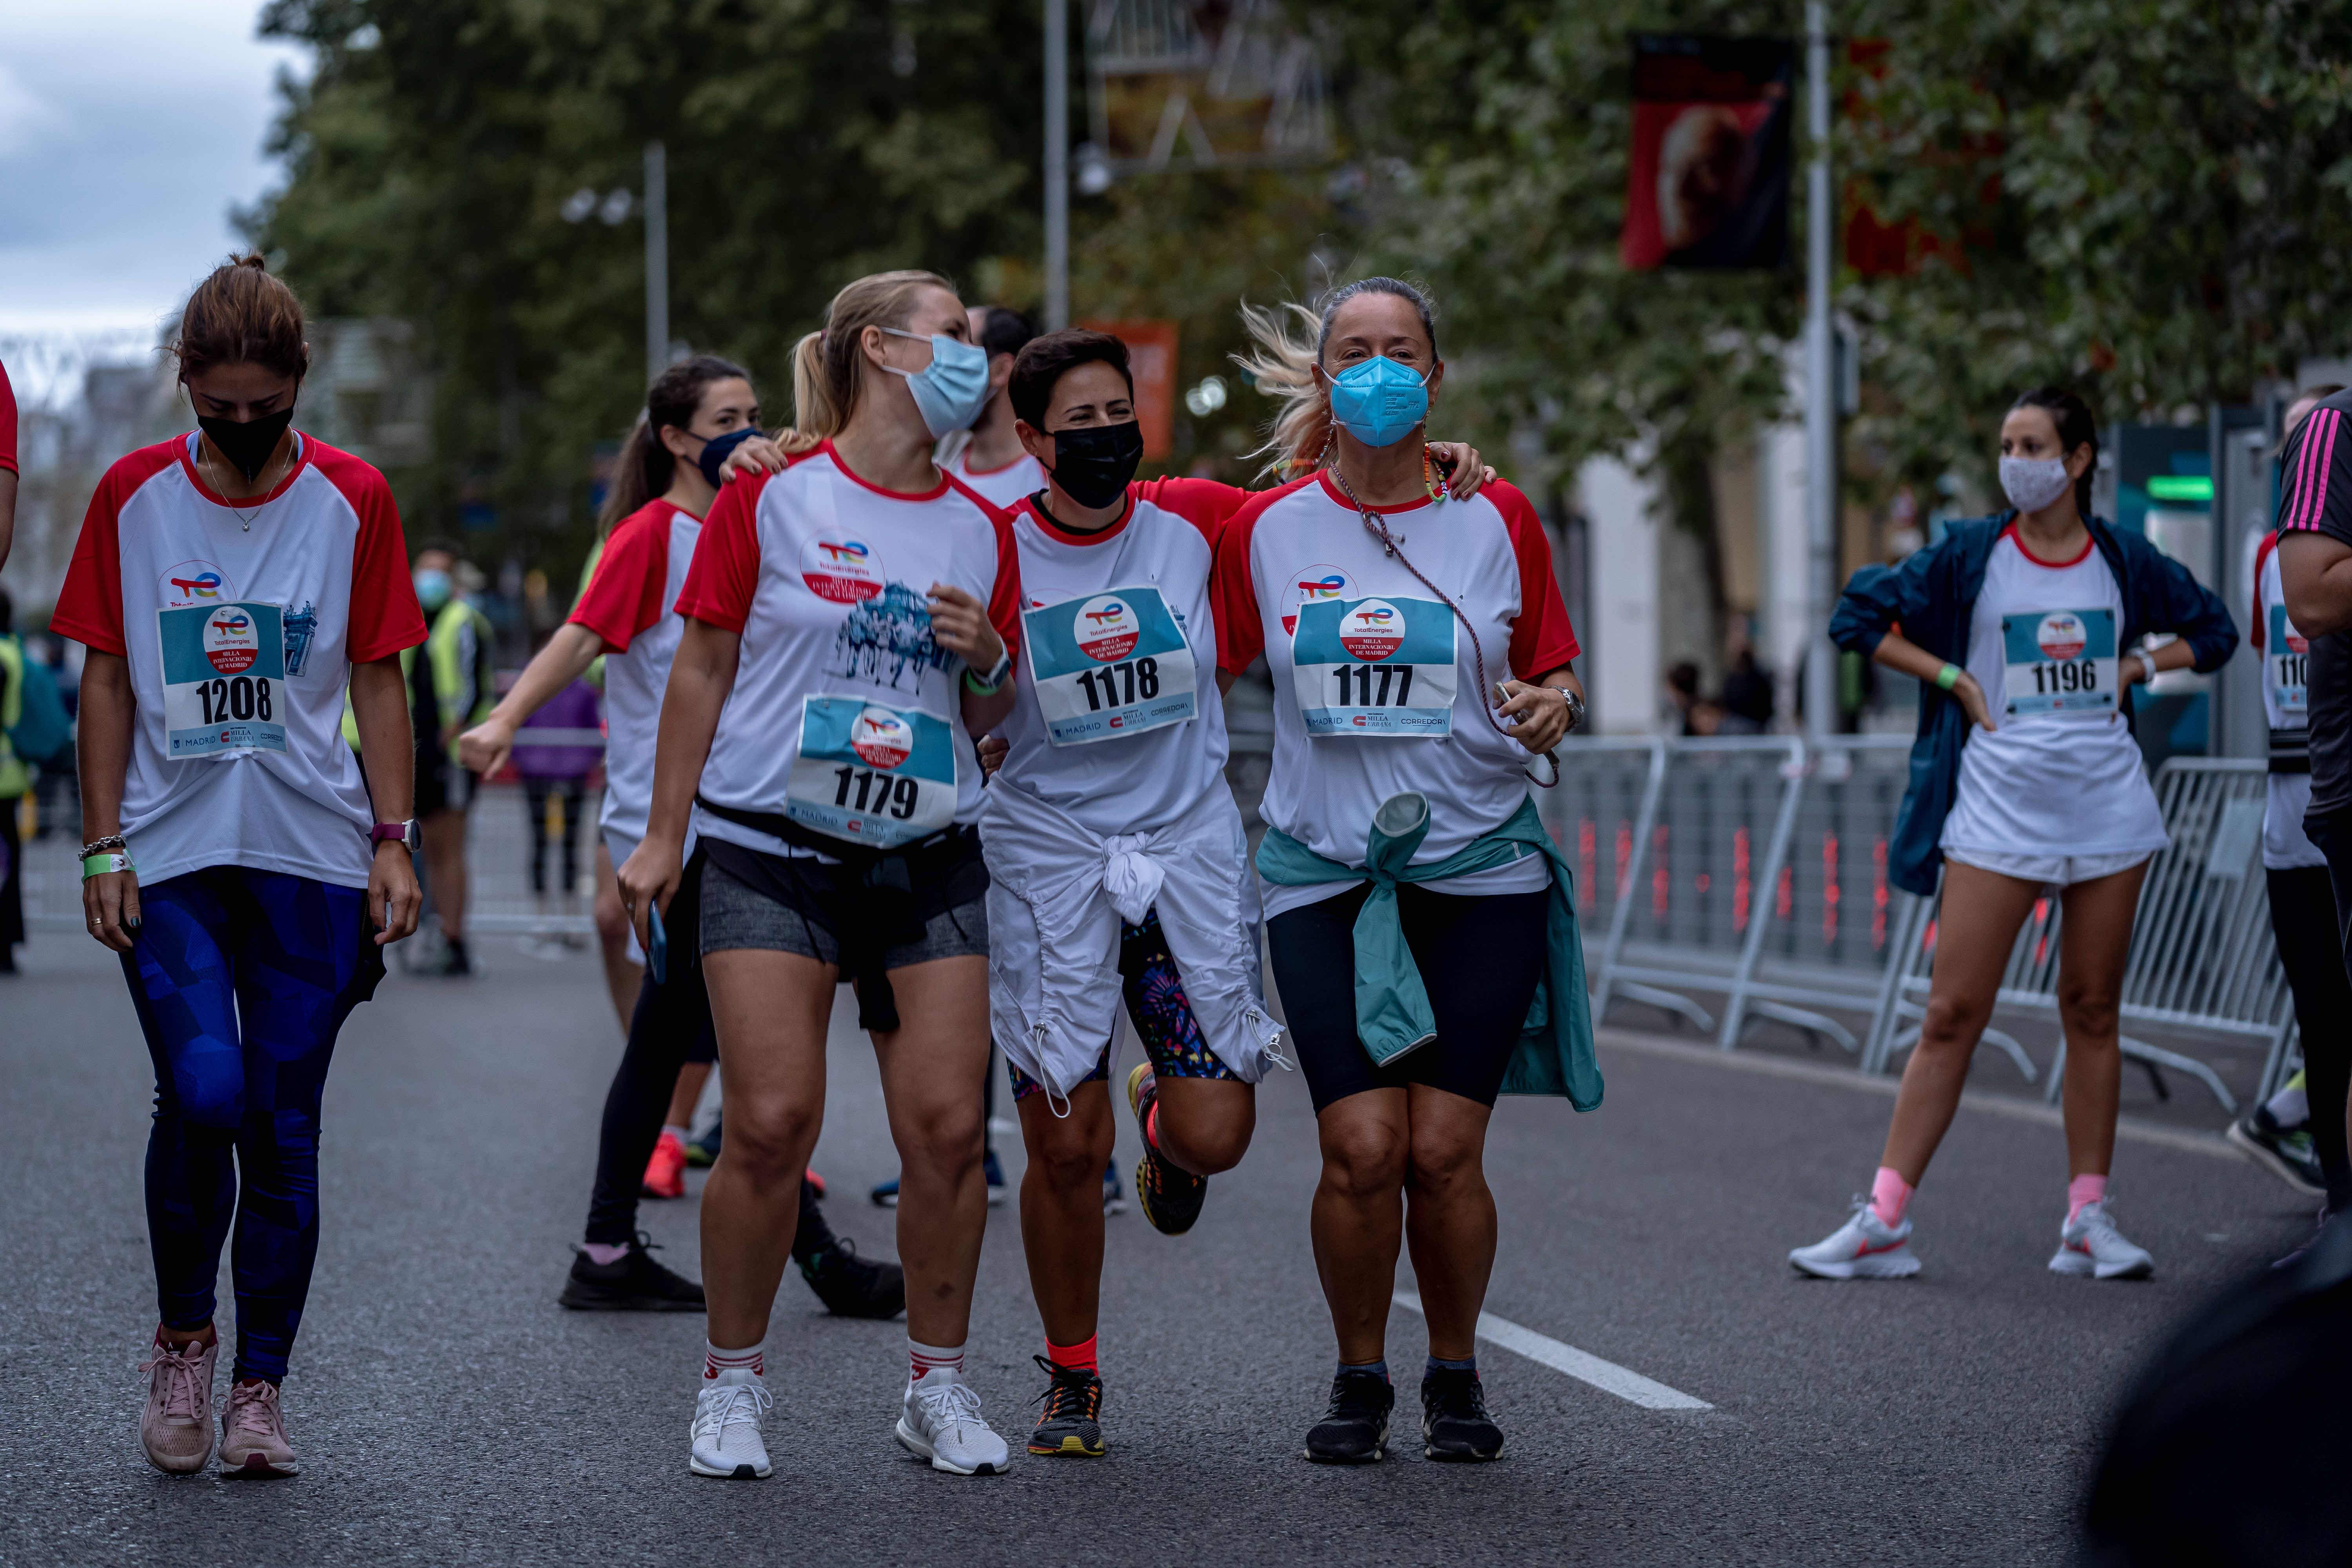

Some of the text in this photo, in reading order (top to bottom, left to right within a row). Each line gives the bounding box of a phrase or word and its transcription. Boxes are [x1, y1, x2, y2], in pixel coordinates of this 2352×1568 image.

[1076, 657, 1159, 711] 1178
[1333, 664, 1413, 706] 1177
[2031, 660, 2096, 693] 1196
[196, 676, 272, 725] 1208
[185, 736, 216, 746] MADRID
[1065, 722, 1101, 736] MADRID
[835, 766, 918, 819] 1179
